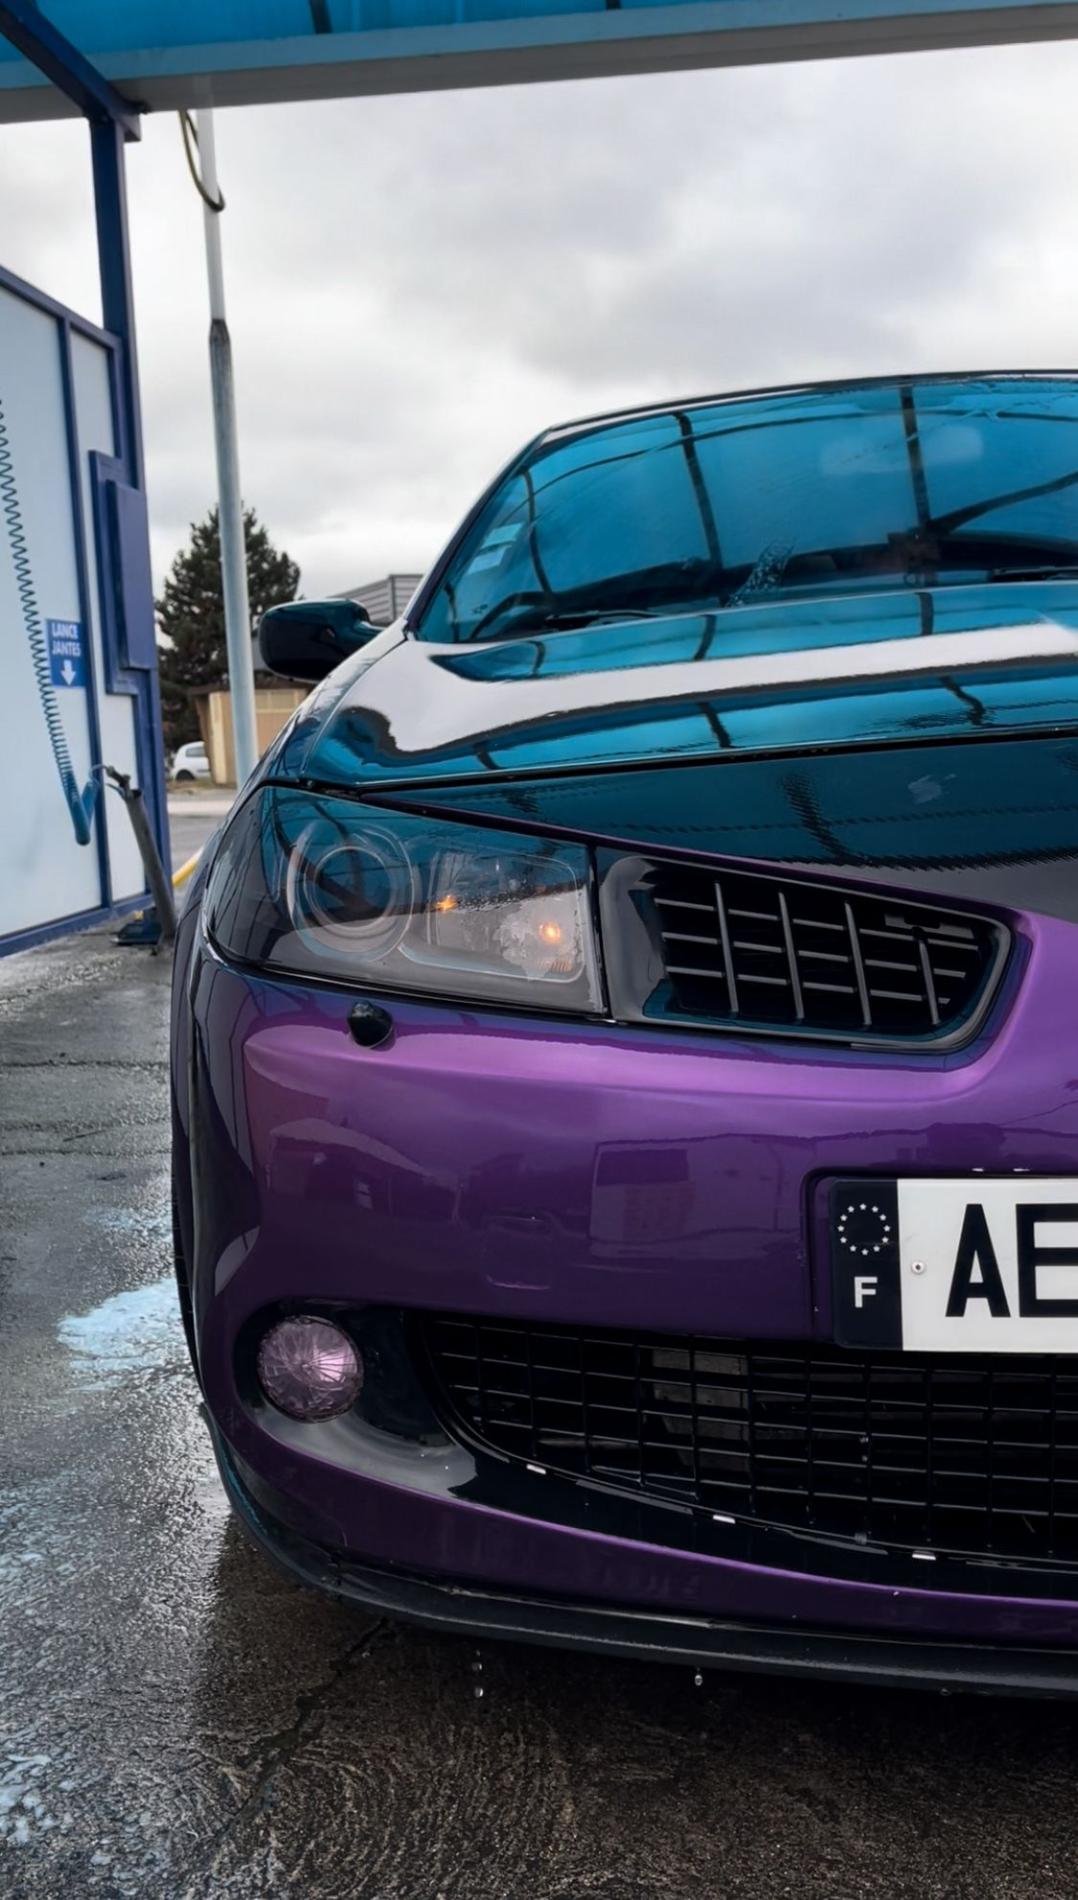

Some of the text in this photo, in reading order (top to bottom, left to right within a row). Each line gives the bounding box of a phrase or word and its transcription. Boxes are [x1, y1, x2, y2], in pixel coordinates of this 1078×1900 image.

[51, 622, 79, 639] LANCE
[52, 641, 81, 657] JANTES
[945, 1203, 1078, 1318] AE
[854, 1276, 878, 1308] F
